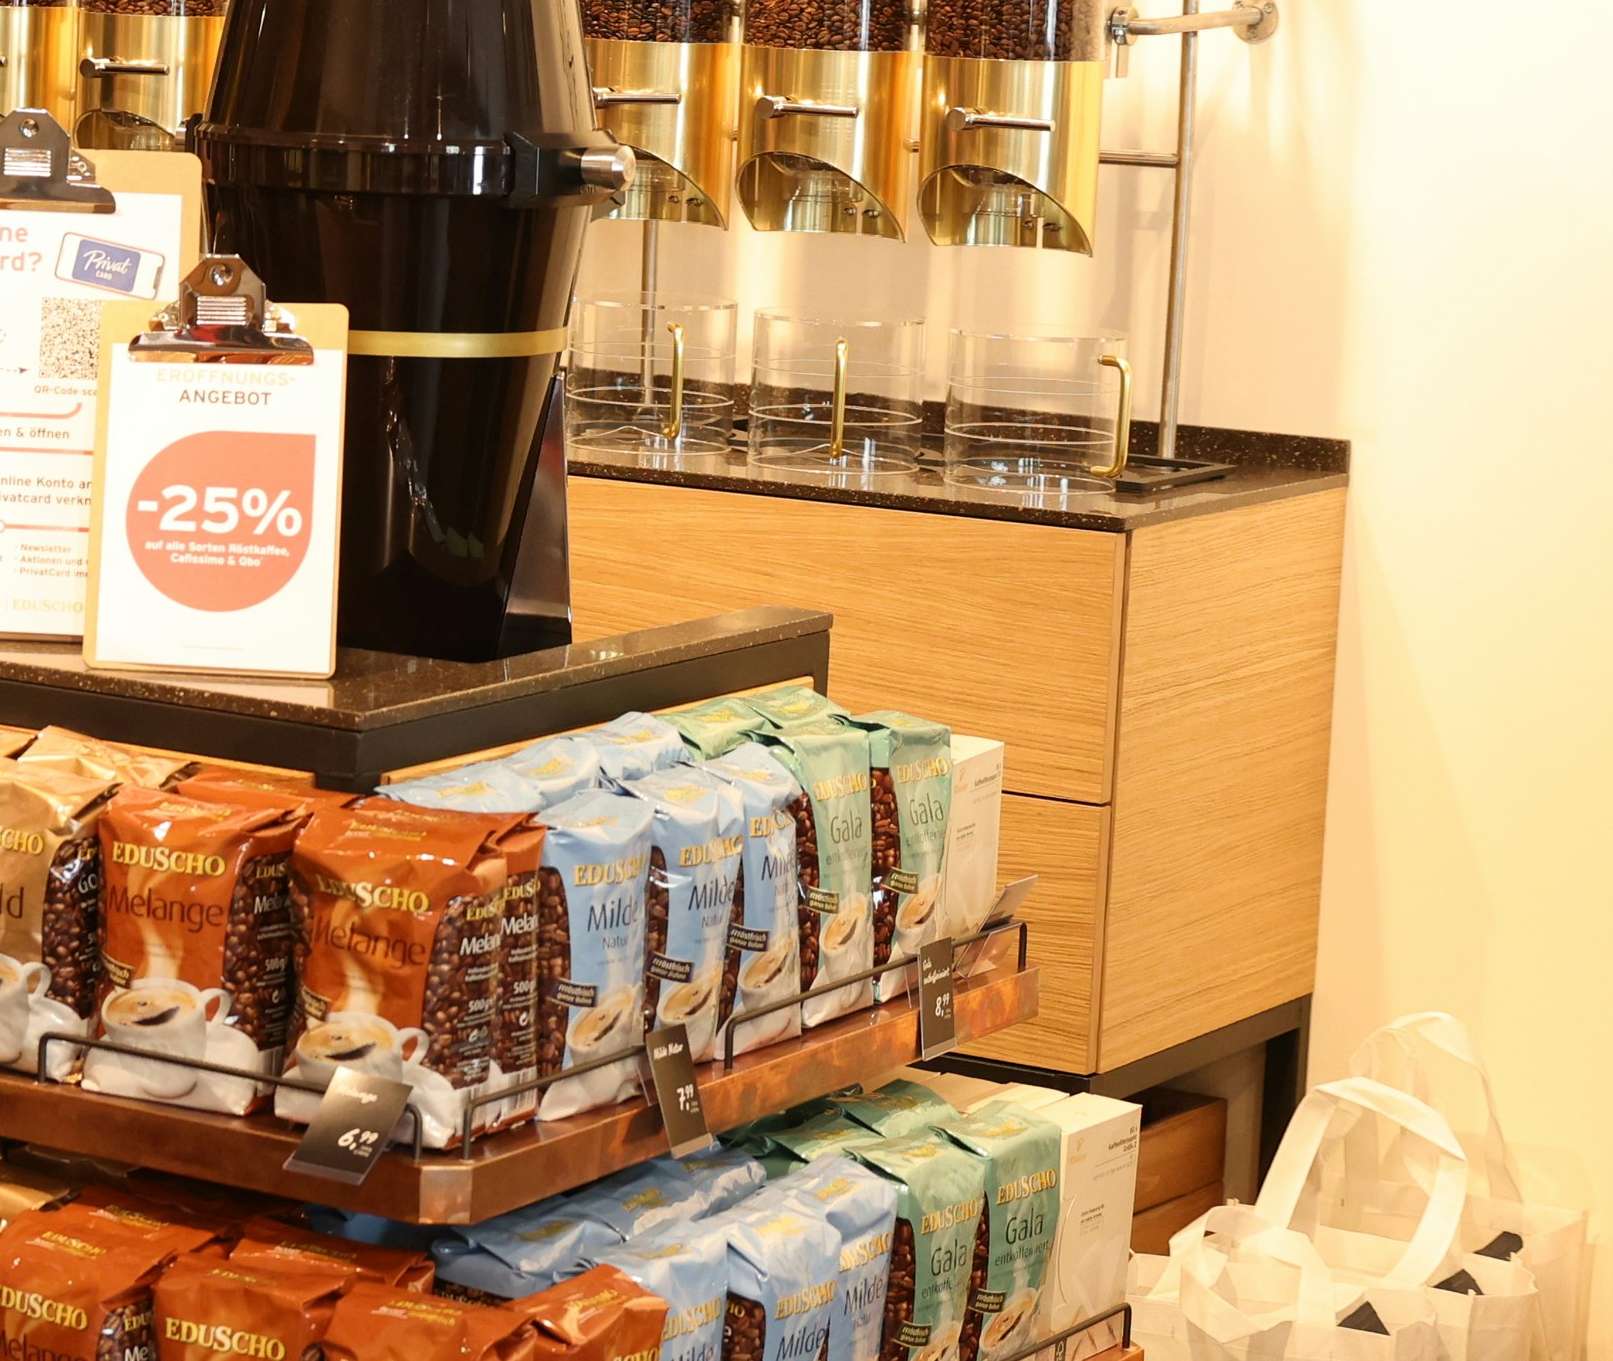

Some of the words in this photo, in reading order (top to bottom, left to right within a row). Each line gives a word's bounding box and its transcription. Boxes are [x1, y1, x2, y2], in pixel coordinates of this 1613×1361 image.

[83, 249, 132, 274] Privat
[157, 368, 296, 386] ERÖFFNUNGS-
[34, 386, 78, 396] QR-Code
[179, 390, 272, 406] ANGEBOT
[16, 427, 24, 437] &
[29, 427, 70, 439] öffnen
[36, 476, 74, 489] Konto
[137, 485, 303, 537] -25%
[145, 540, 163, 551] auf
[165, 541, 186, 551] alle
[188, 542, 225, 553] Sorten
[170, 553, 224, 566] Cafissimo
[227, 556, 236, 566] &
[112, 841, 226, 878] EDUSCHO
[688, 876, 735, 911] Milde
[108, 889, 225, 934] Melange
[587, 895, 640, 932] Milde
[313, 916, 427, 969] Melange
[337, 1127, 379, 1153] 6,99
[997, 1168, 1058, 1206] EDUSCHO
[1005, 1207, 1044, 1245] Gala
